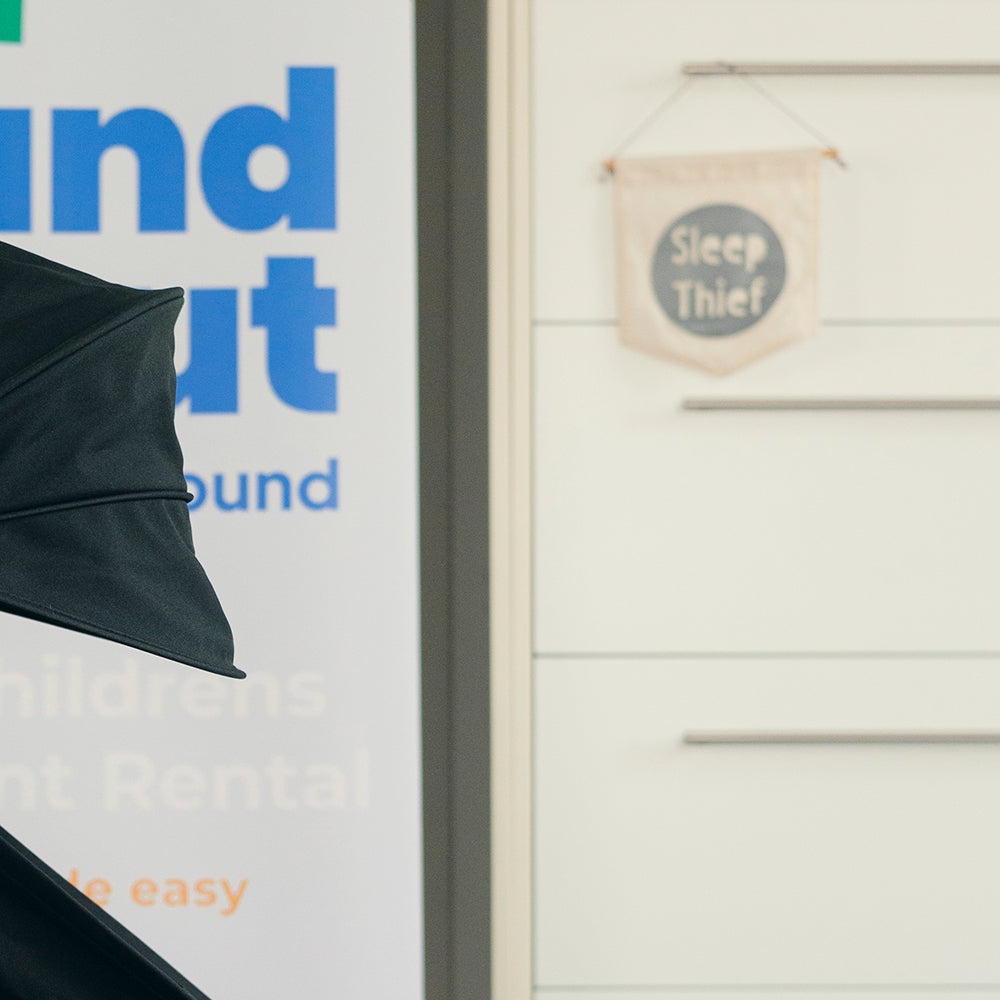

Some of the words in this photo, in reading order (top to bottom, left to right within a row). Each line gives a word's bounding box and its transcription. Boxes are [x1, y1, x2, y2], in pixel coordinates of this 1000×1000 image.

[670, 223, 768, 273] Sleep
[672, 277, 768, 320] Thief
[104, 746, 372, 812] Rental
[131, 876, 250, 917] easy
